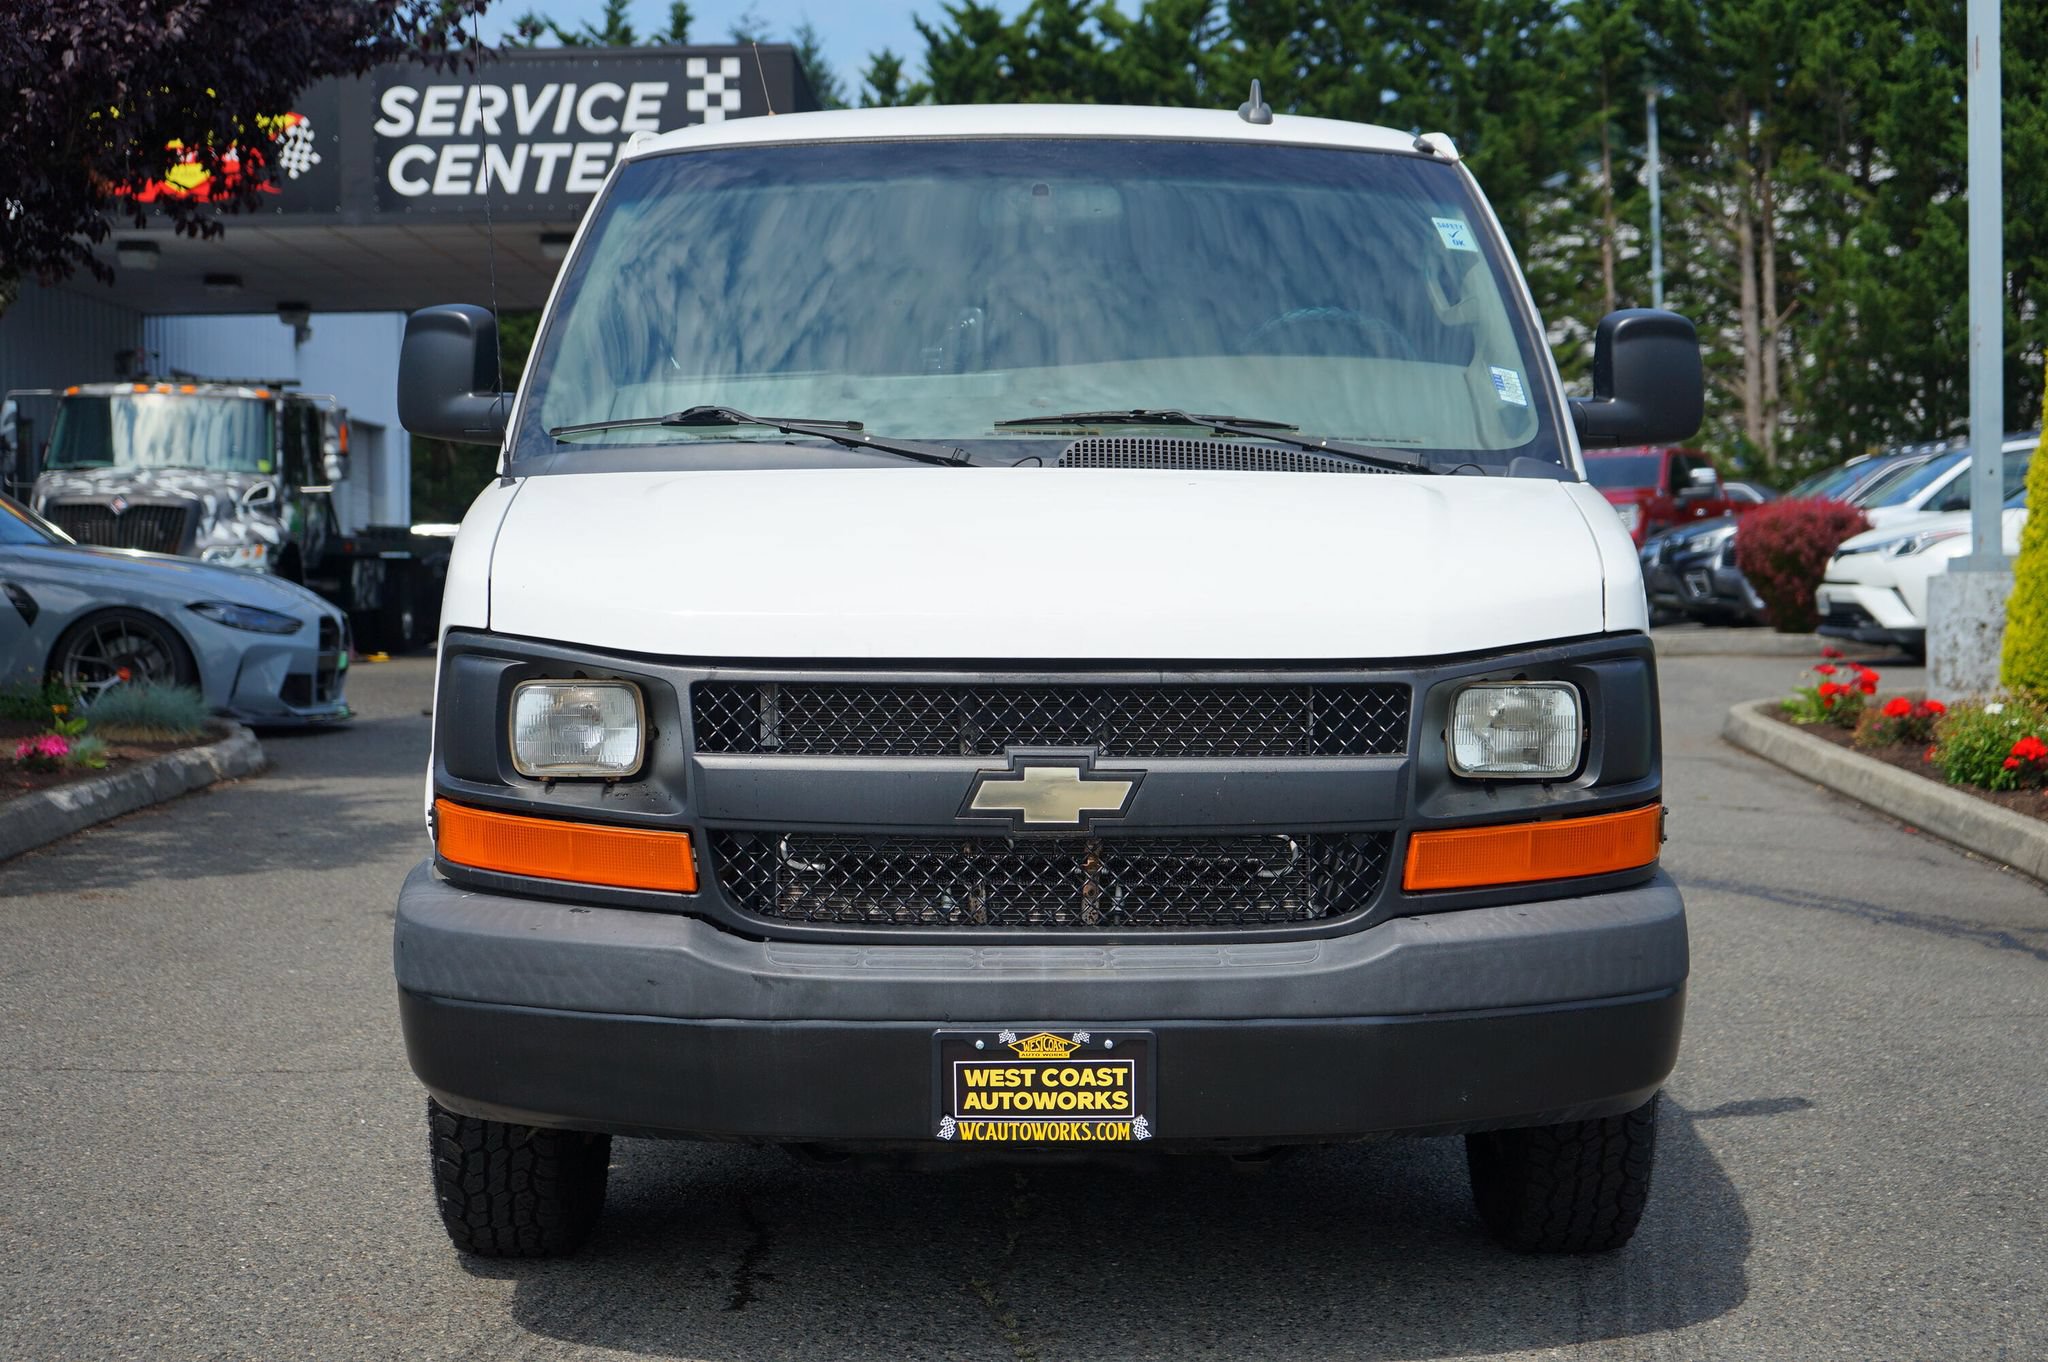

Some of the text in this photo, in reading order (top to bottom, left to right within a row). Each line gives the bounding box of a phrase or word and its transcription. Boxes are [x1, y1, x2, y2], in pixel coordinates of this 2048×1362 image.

[374, 82, 669, 137] SERVICE
[964, 1067, 1128, 1087] WEST COAST
[963, 1091, 1129, 1111] AUTOWORKS
[957, 1121, 1131, 1141] WCAUTOWORKS.COM
